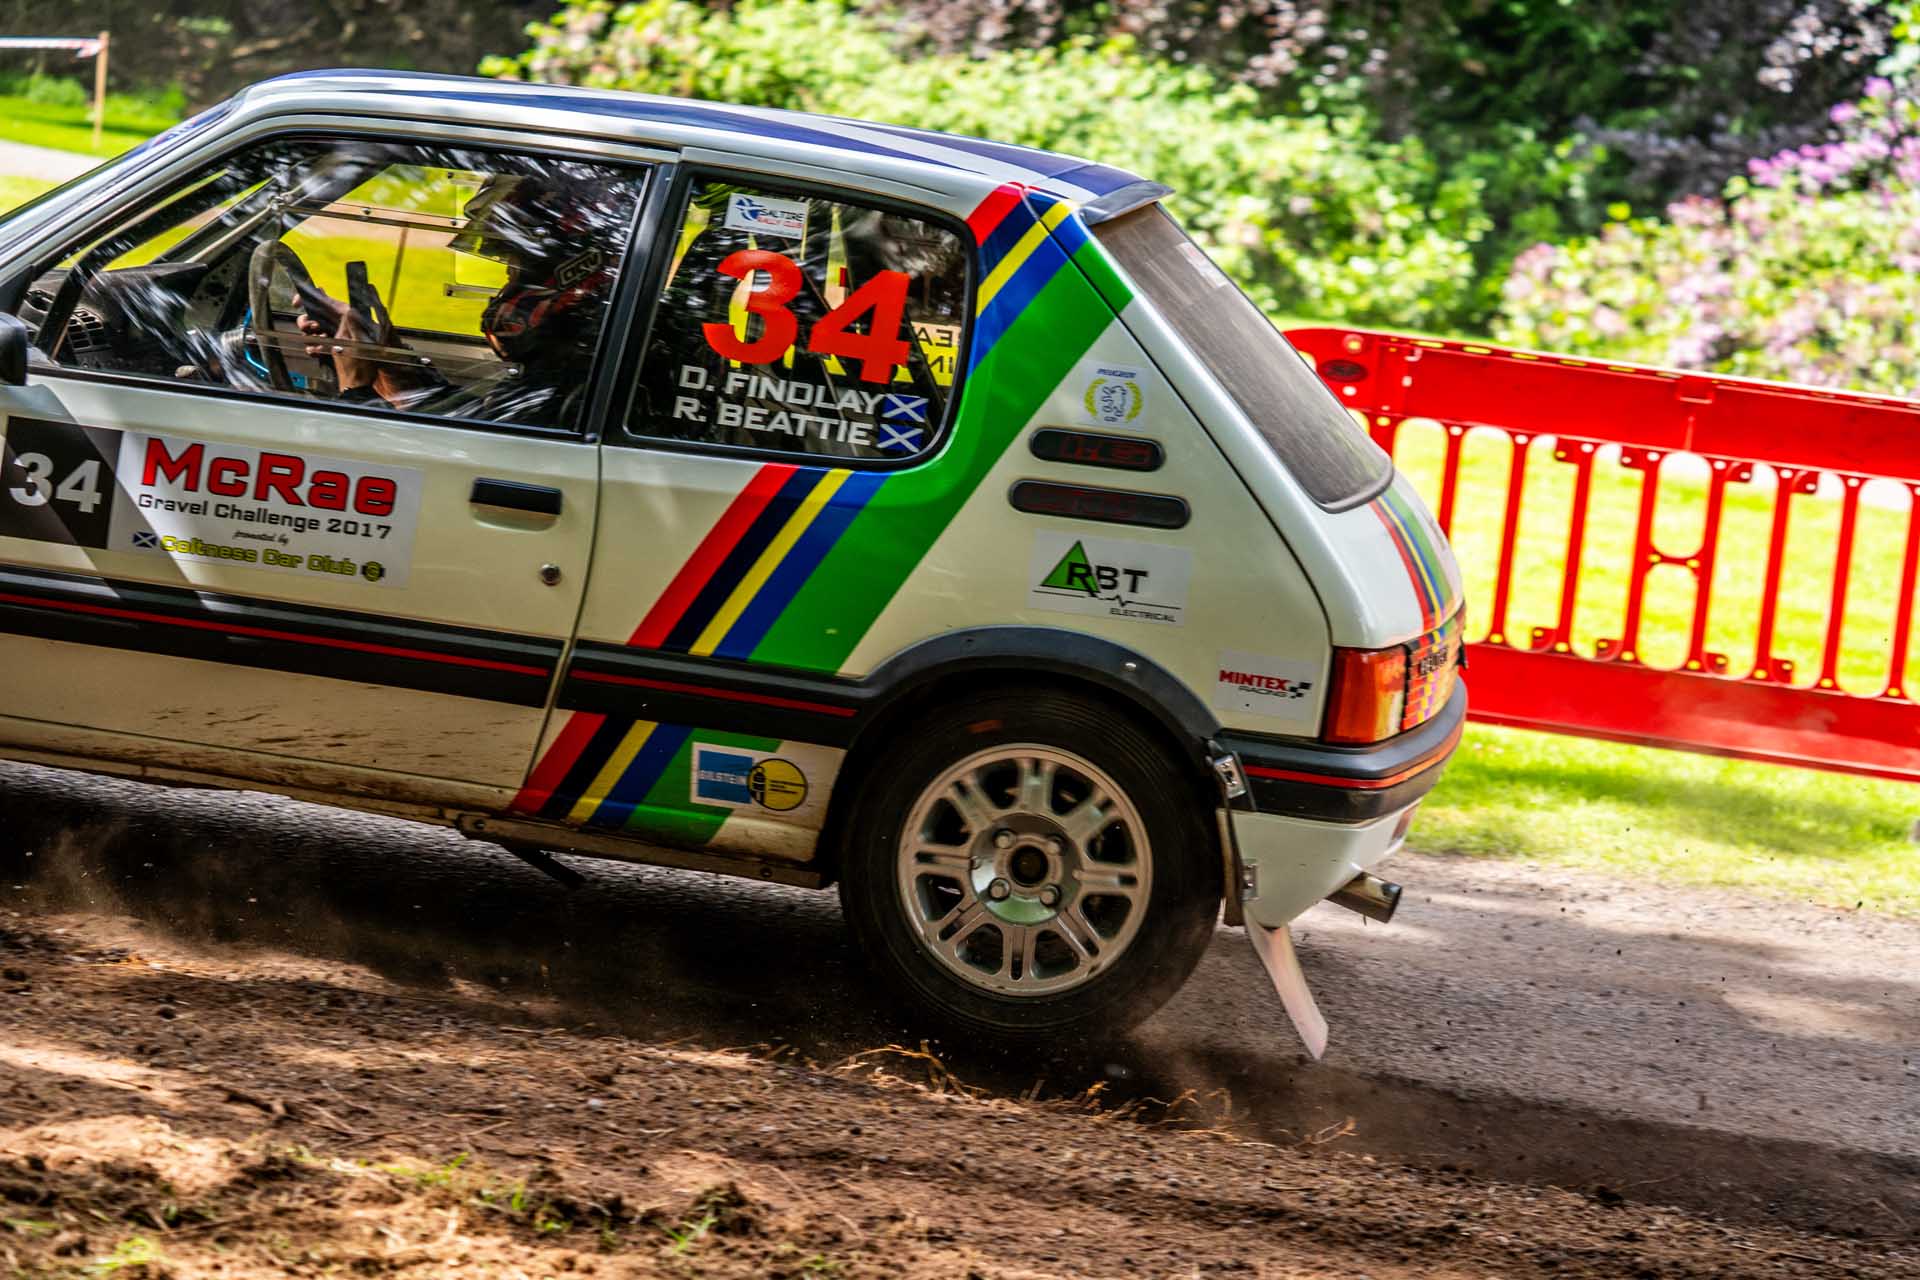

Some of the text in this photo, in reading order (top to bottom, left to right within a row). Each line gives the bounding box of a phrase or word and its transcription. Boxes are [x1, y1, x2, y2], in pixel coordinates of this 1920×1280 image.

[702, 249, 912, 384] 34
[678, 364, 886, 416] D. FINDLAY
[672, 395, 874, 446] R. BEATTIE
[8, 452, 103, 514] 34
[140, 437, 398, 518] McRae
[138, 493, 392, 540] Gravel Challenge 2017
[160, 534, 357, 577] Coltness Car Club
[1066, 560, 1149, 597] RBT
[1110, 607, 1176, 622] ELECTRICAL
[1219, 669, 1292, 693] MINTEX
